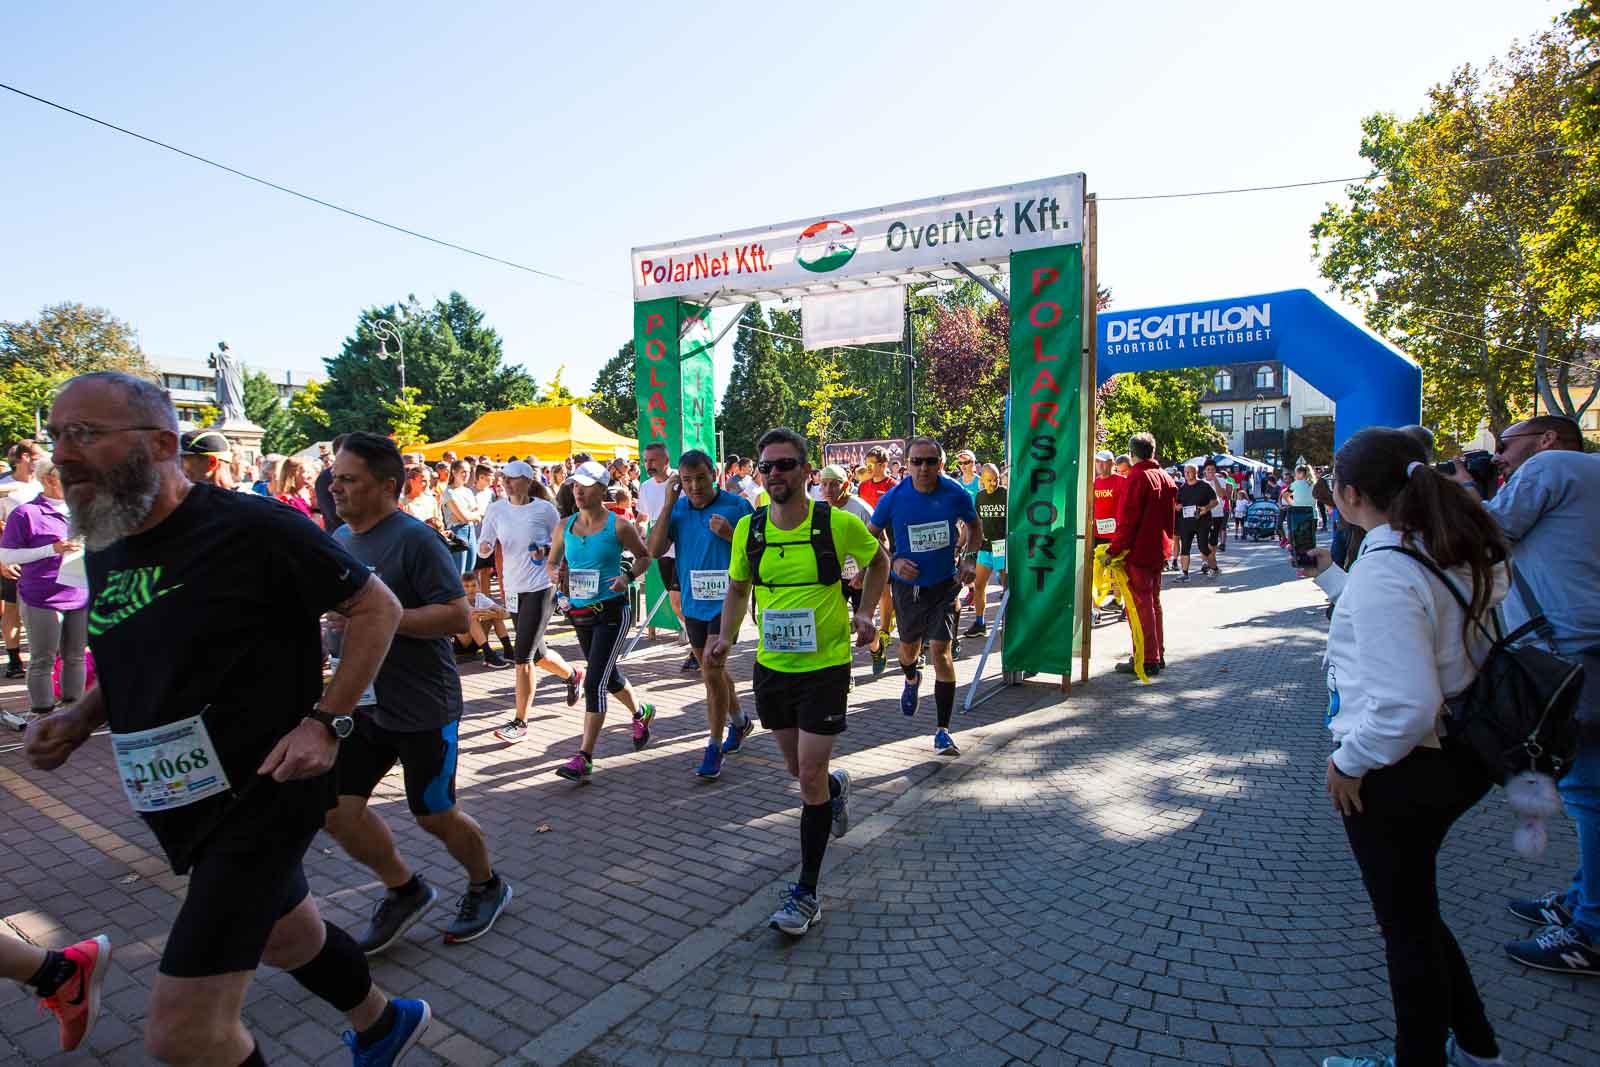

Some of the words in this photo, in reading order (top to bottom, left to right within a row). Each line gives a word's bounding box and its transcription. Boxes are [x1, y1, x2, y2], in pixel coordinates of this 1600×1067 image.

[886, 206, 1003, 252] OverNet
[1014, 197, 1069, 235] Kft.
[641, 252, 729, 286] PolarNet
[735, 244, 773, 274] Kft.
[1106, 303, 1271, 343] DECATHLON
[1107, 338, 1171, 355] SPORTBÓL
[1179, 338, 1185, 349] A
[1193, 329, 1272, 347] LEGTÖBBET
[979, 504, 1005, 512] VEGAN
[775, 624, 812, 638] 21117
[133, 748, 209, 784] 21068
